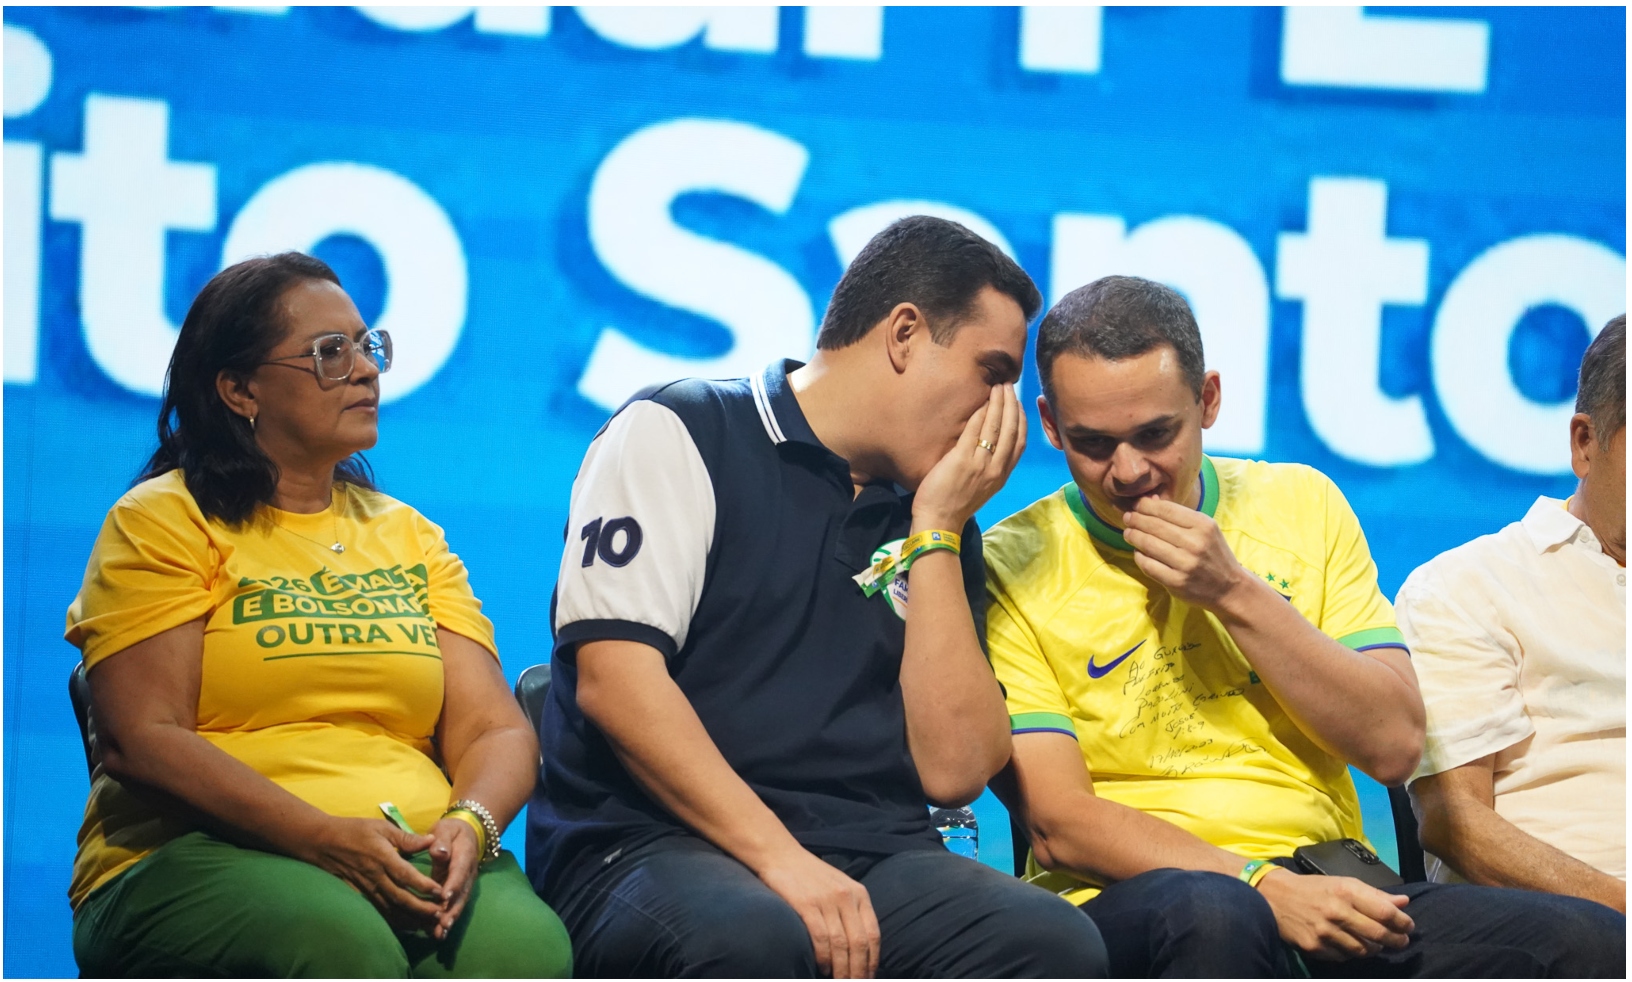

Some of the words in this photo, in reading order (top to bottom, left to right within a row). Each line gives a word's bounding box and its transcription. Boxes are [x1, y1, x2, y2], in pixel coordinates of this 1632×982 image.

[577, 117, 1626, 473] Snto
[580, 515, 643, 568] 10
[243, 596, 262, 617] E
[273, 593, 428, 616] BOLSONAR
[256, 623, 393, 649] OUTRA
